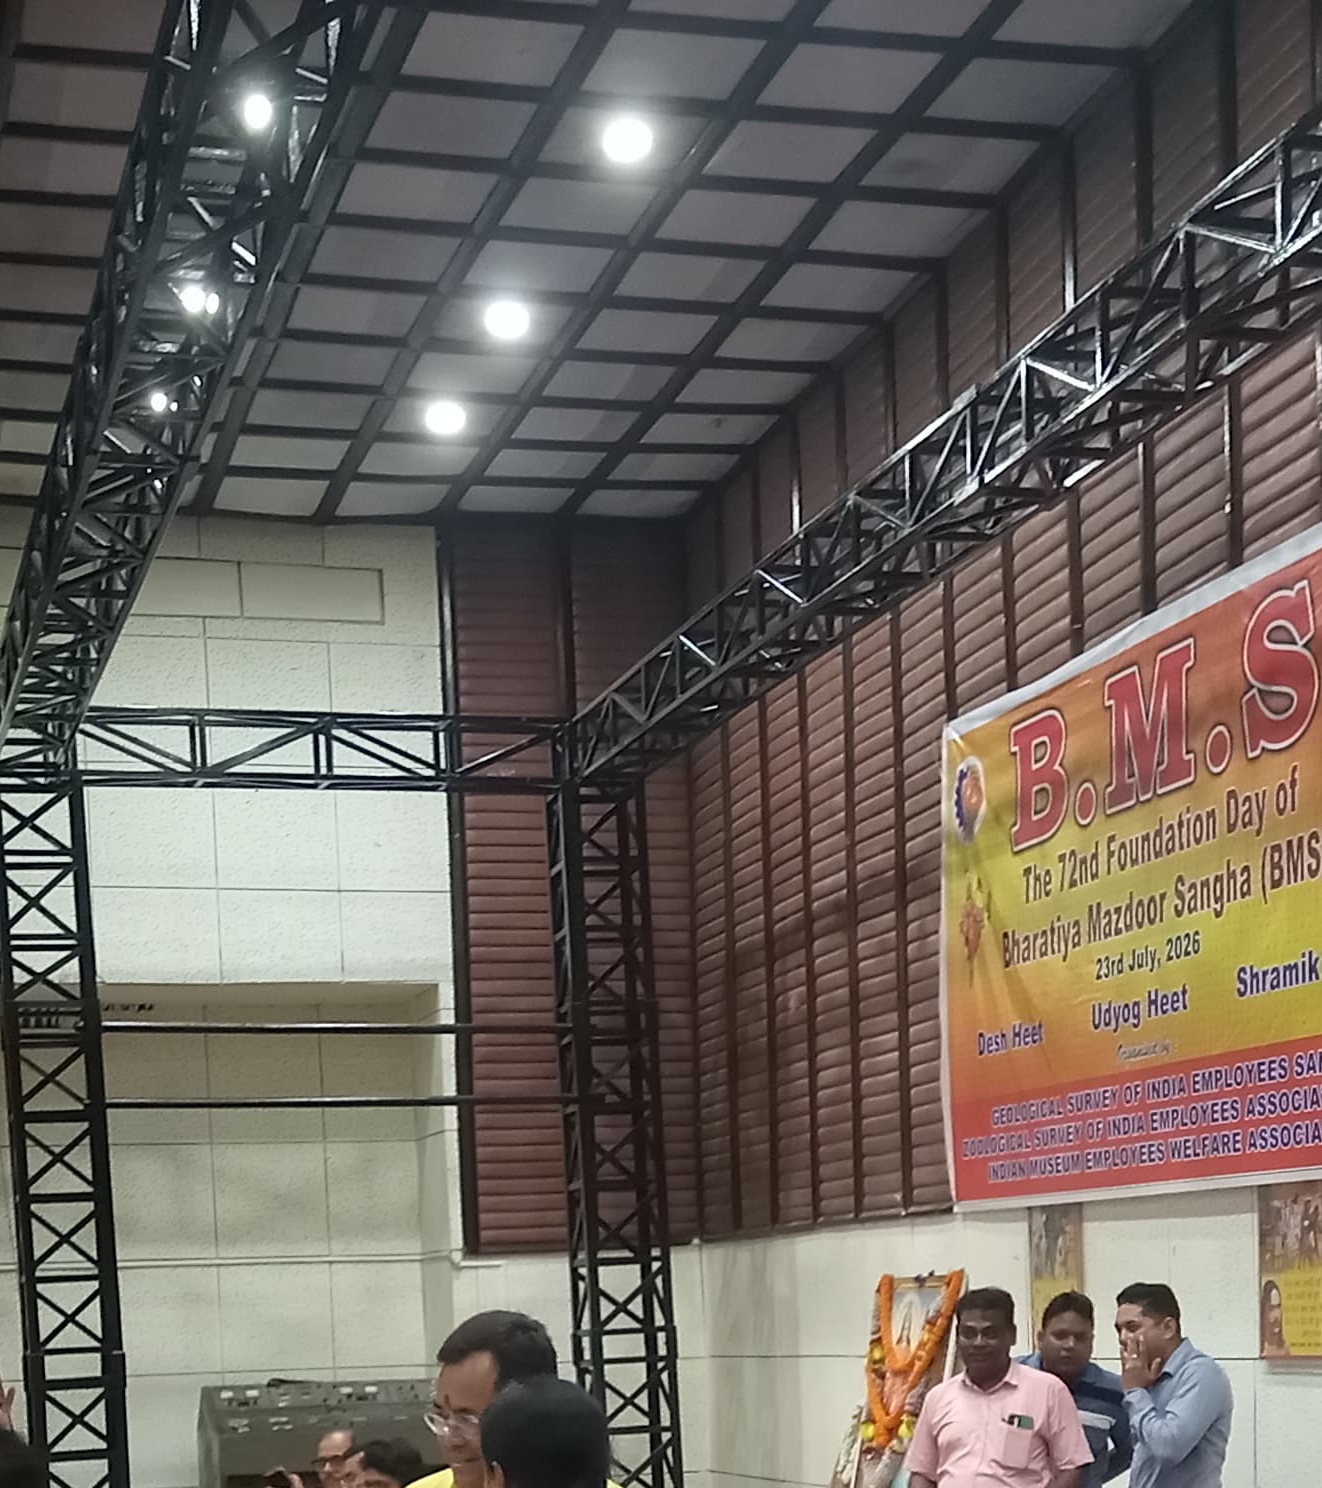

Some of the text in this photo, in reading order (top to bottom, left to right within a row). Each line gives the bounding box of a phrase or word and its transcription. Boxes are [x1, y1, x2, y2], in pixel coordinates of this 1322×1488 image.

[1010, 579, 1320, 851] B.M.S
[1023, 763, 1299, 904] The 72nd Foundation Day of
[1002, 915, 1081, 968] Bharatiya
[1087, 890, 1167, 944] Mazdoor
[1173, 859, 1252, 919] Sangha
[1095, 931, 1201, 980] 23rd July, 2026
[1236, 950, 1320, 998] Shramik
[1092, 983, 1189, 1033] Udyog Heet
[978, 1021, 1043, 1055] Desh Heet
[992, 1101, 1064, 1126] GEOLOGICAL
[1068, 1088, 1118, 1113] SURVEY
[1124, 1084, 1141, 1104] OF
[1147, 1076, 1186, 1099] INDIA
[1192, 1057, 1288, 1093] EMPLOYEES
[963, 1132, 1031, 1157] ZOOLOGICAL
[1035, 1122, 1081, 1147] SURVEY
[1086, 1120, 1104, 1141] OF
[1108, 1114, 1145, 1137] INDIA
[1150, 1099, 1239, 1132] EMPLOYEES
[989, 1160, 1027, 1182] INDIAN
[1030, 1153, 1081, 1178] MUSEUM
[1086, 1143, 1165, 1170] EMPLOYEES
[1170, 1131, 1242, 1160] WELFARE
